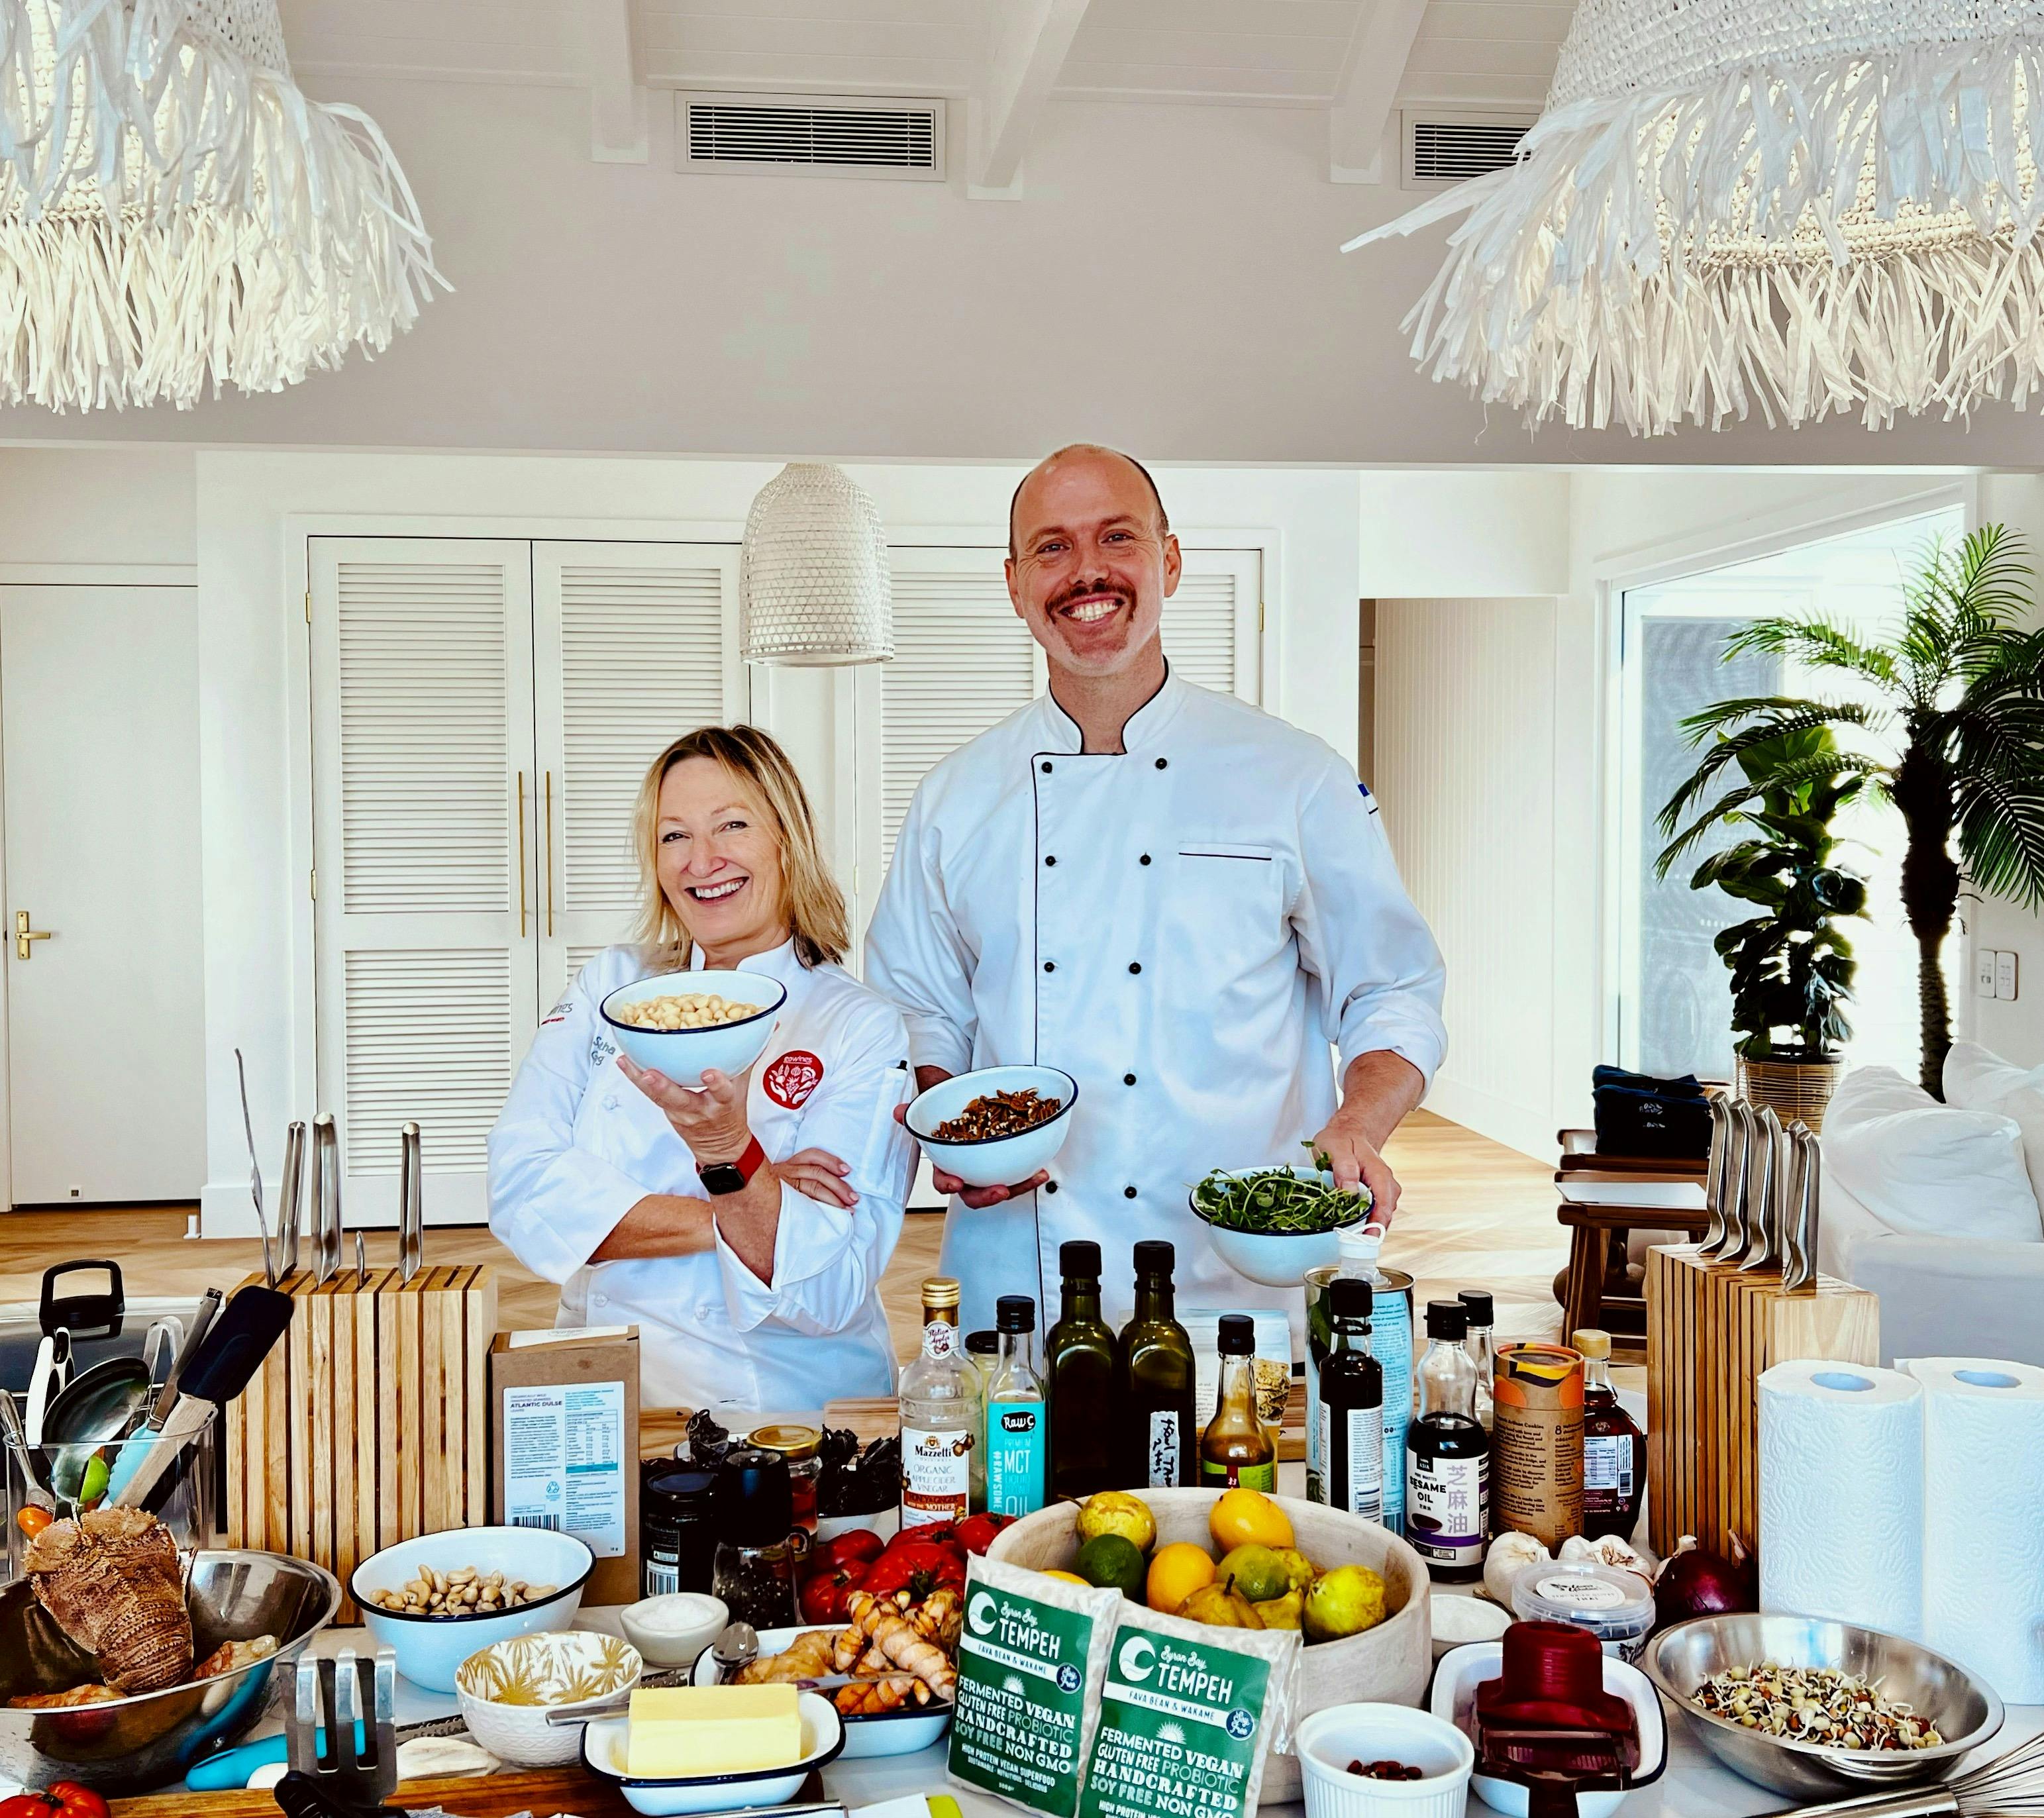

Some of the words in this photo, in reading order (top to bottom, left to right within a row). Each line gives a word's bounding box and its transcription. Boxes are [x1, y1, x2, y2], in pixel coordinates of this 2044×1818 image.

[1555, 1425, 1562, 1435] 8
[915, 1444, 952, 1458] Mazzetti
[1004, 1450, 1031, 1474] MCT
[911, 1474, 930, 1484] APPLE
[913, 1464, 952, 1474] ORGANIC
[1409, 1476, 1447, 1493] SESAME
[917, 1484, 948, 1493] VINEGAR
[1417, 1491, 1433, 1503] OIL
[1447, 1465, 1468, 1534] 芝麻油
[1005, 1495, 1029, 1517] OIL
[999, 1617, 1061, 1660] TEMPEH
[978, 1644, 992, 1656] FAVA
[994, 1649, 1011, 1662] BEAN
[1012, 1655, 1017, 1664] &
[1019, 1658, 1047, 1675] WAKAME
[1160, 1644, 1188, 1664] Byron
[1187, 1650, 1208, 1672] Bay
[1157, 1662, 1233, 1705] TEMPEH
[958, 1675, 1023, 1710] FERMENTED
[1025, 1701, 1076, 1729] VEGAN
[958, 1690, 986, 1713] GLUTEN
[987, 1701, 1006, 1721] FREE
[1007, 1709, 1074, 1743] PROBIOTIC
[1129, 1690, 1147, 1703] FAVA
[1149, 1696, 1170, 1711] BEAN
[1172, 1701, 1178, 1711] &
[1181, 1703, 1215, 1721] WAKAME
[956, 1704, 1072, 1758] HANDCRAFTED
[954, 1720, 975, 1739] SOY
[976, 1729, 1003, 1752] FREE
[1005, 1741, 1035, 1764] NON
[1035, 1753, 1072, 1774] GMO
[1100, 1726, 1182, 1761] FERMENTED
[1185, 1749, 1245, 1780] VEGAN
[961, 1742, 975, 1756] HIGH
[975, 1748, 999, 1766] PROTEIN
[1000, 1758, 1019, 1774] VEGAN
[1019, 1766, 1056, 1787] SUPERFOOD
[1098, 1742, 1135, 1766] GLUTEN
[1135, 1752, 1160, 1773] FREE
[1161, 1759, 1240, 1794] PROBIOTIC
[1090, 1775, 1117, 1795] SOY
[1119, 1783, 1153, 1806] FREE
[1155, 1793, 1194, 1817] NON
[1093, 1758, 1239, 1811] HANDCRAFTED
[1098, 1799, 1115, 1815] HIGH
[1115, 1804, 1147, 1818] PROTEIN
